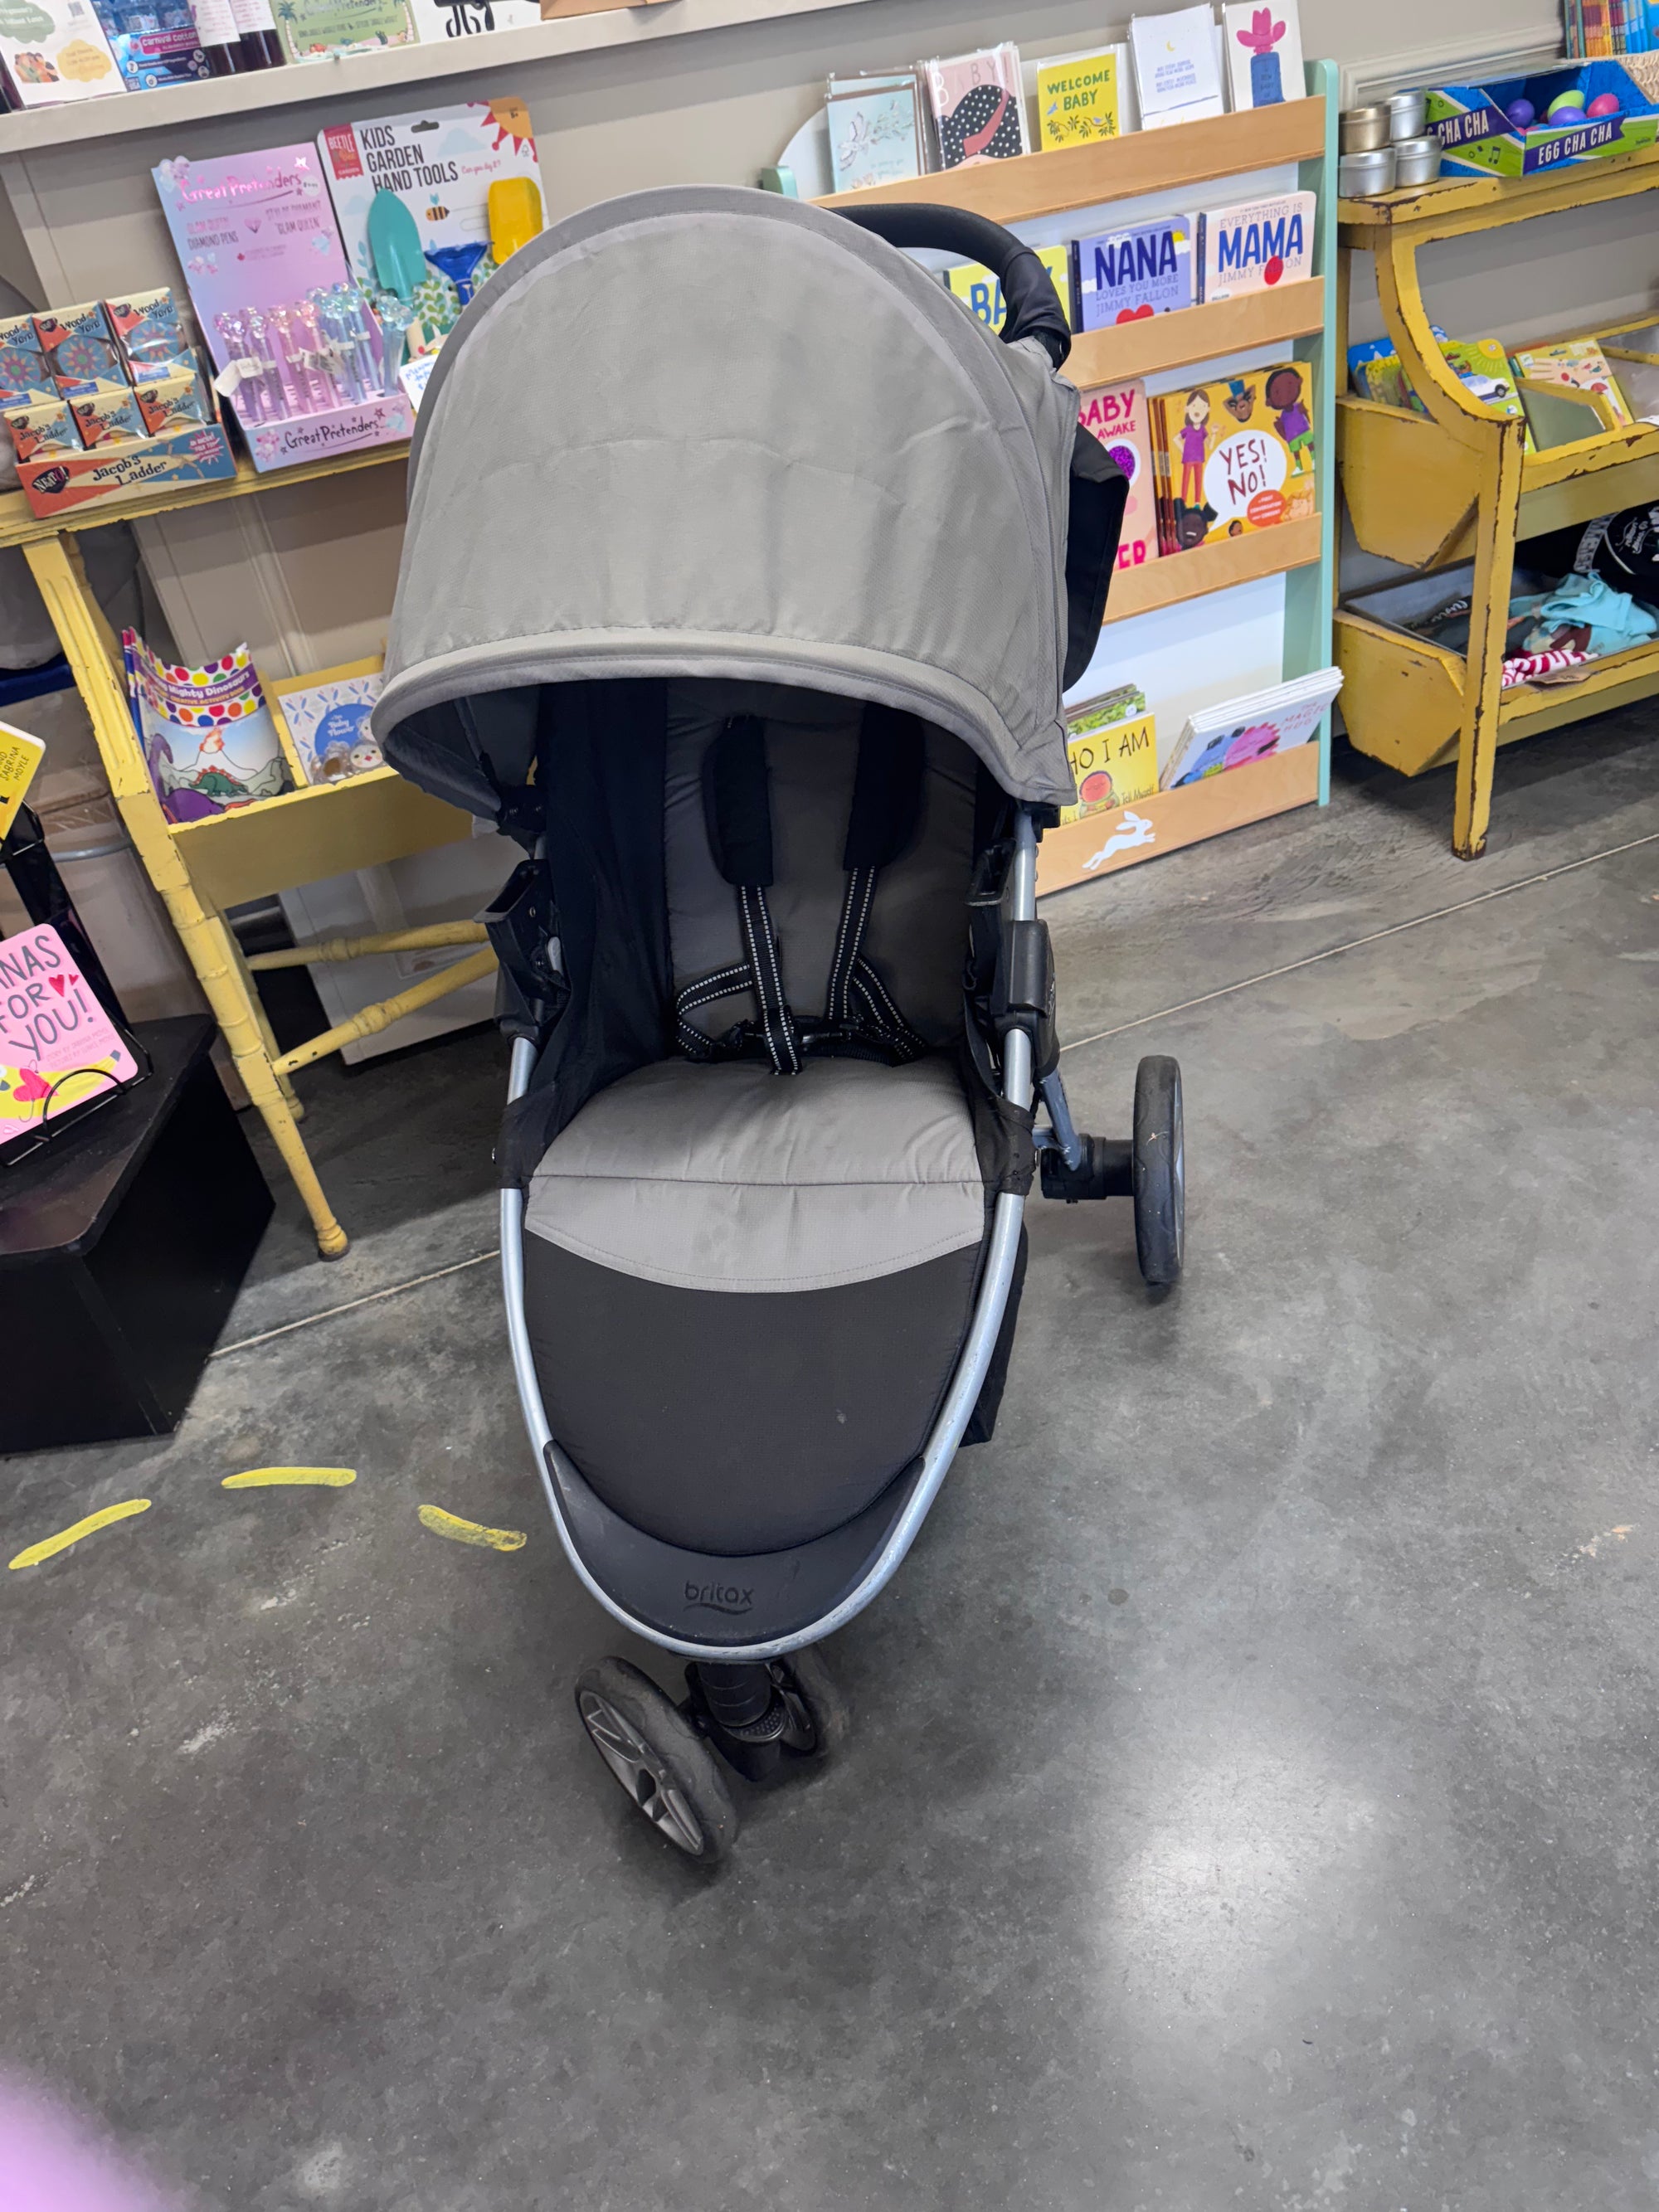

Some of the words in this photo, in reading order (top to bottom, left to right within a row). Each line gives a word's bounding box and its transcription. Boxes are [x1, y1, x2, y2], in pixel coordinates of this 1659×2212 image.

[1047, 69, 1111, 95] WELCOME
[1063, 89, 1099, 112] BABY
[359, 125, 396, 151] KIDS
[1438, 123, 1462, 147] CHA
[1464, 109, 1490, 139] CHA
[327, 134, 355, 153] BEETLE
[1537, 144, 1560, 166] EGG
[1564, 134, 1586, 156] CHA
[1589, 122, 1613, 146] CHA
[366, 143, 425, 173] GARDEN
[180, 175, 228, 204] Great
[372, 169, 413, 193] HAND
[413, 161, 459, 188] TOOLS
[1219, 205, 1289, 229] EVERYTHING
[1293, 202, 1303, 213] IS
[187, 234, 220, 250] DIAMOND
[220, 231, 239, 245] PENS
[1219, 213, 1303, 273] MAMA
[1094, 231, 1178, 290] NANA
[1096, 286, 1126, 301] LOVES
[1128, 280, 1149, 293] YOU
[1151, 274, 1179, 288] MORE
[1217, 266, 1254, 287] JIMMY
[133, 299, 160, 316] Wood
[1096, 296, 1131, 317] JIMMY
[1135, 285, 1179, 305] FALLON
[59, 314, 87, 331] Wood
[85, 411, 117, 428] Jacob's
[148, 397, 179, 415] Jacob's
[163, 400, 197, 418] Ladder
[19, 423, 51, 441] Jacob's
[34, 426, 68, 444] Ladder
[100, 413, 133, 431] Ladder
[284, 429, 321, 450] Great
[321, 416, 379, 444] Pretenders
[1097, 421, 1136, 440] AWAKE
[92, 455, 142, 482] Jacob's
[1219, 438, 1267, 475] YES!
[32, 465, 70, 493] NEATO!
[114, 460, 168, 486] Ladder
[1227, 464, 1267, 505] NO!
[168, 684, 204, 699] Mighty
[205, 670, 251, 697] Dinosaurs
[0, 746, 20, 781] SABRINA
[1070, 747, 1094, 775] HO
[1102, 738, 1111, 763] I
[1118, 726, 1150, 758] AM
[13, 754, 30, 781] MOYLE
[8, 988, 94, 1062] YOU!
[684, 1580, 754, 1606] britax
